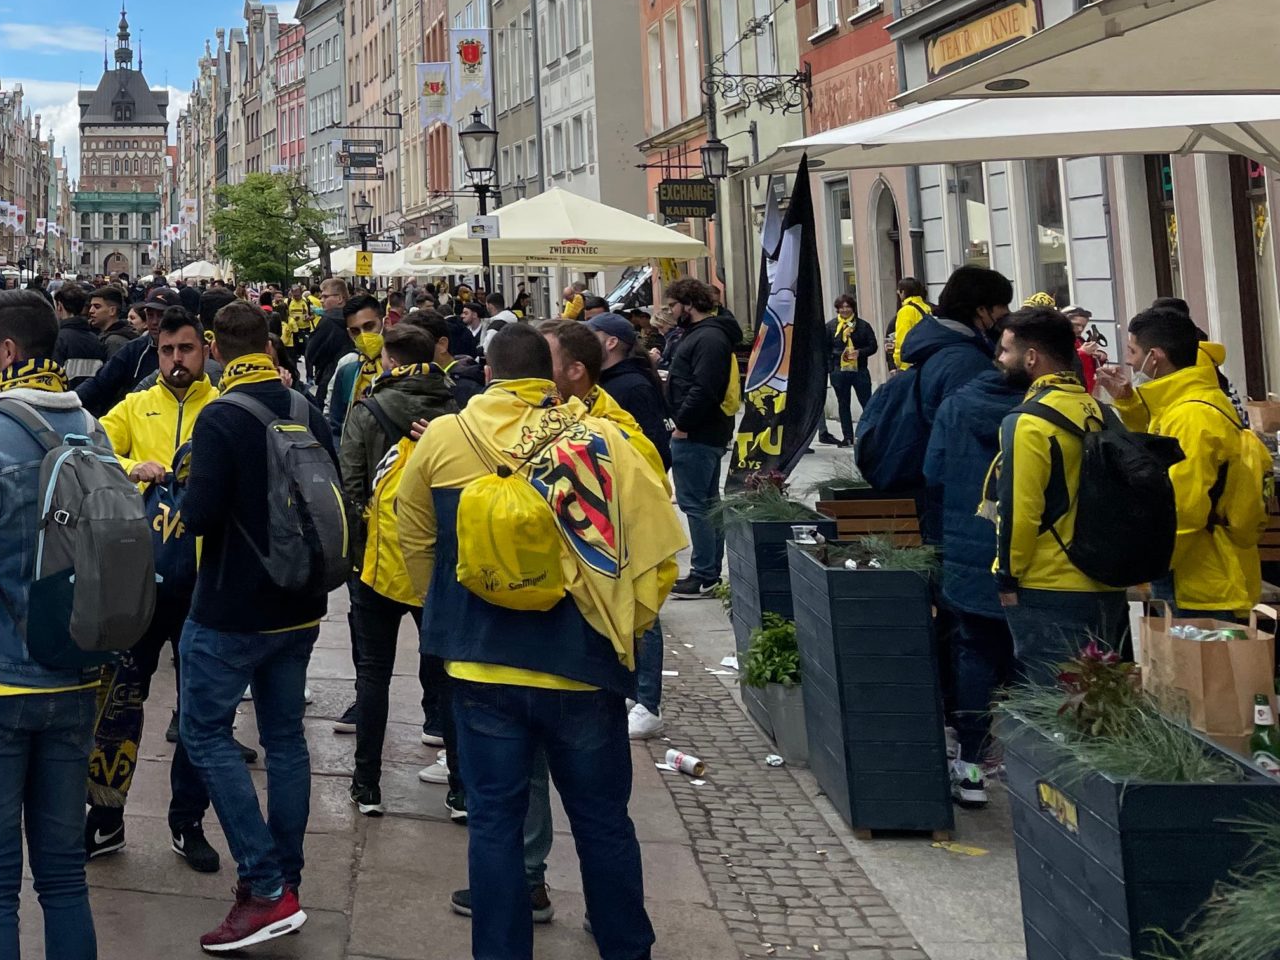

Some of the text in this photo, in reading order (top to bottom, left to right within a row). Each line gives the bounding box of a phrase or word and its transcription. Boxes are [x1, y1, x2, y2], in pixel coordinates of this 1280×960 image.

[983, 6, 1021, 44] OKNIE
[661, 184, 714, 200] EXCHANGE
[665, 205, 708, 217] KANTOR
[549, 246, 599, 255] ZWIERZYNIEC
